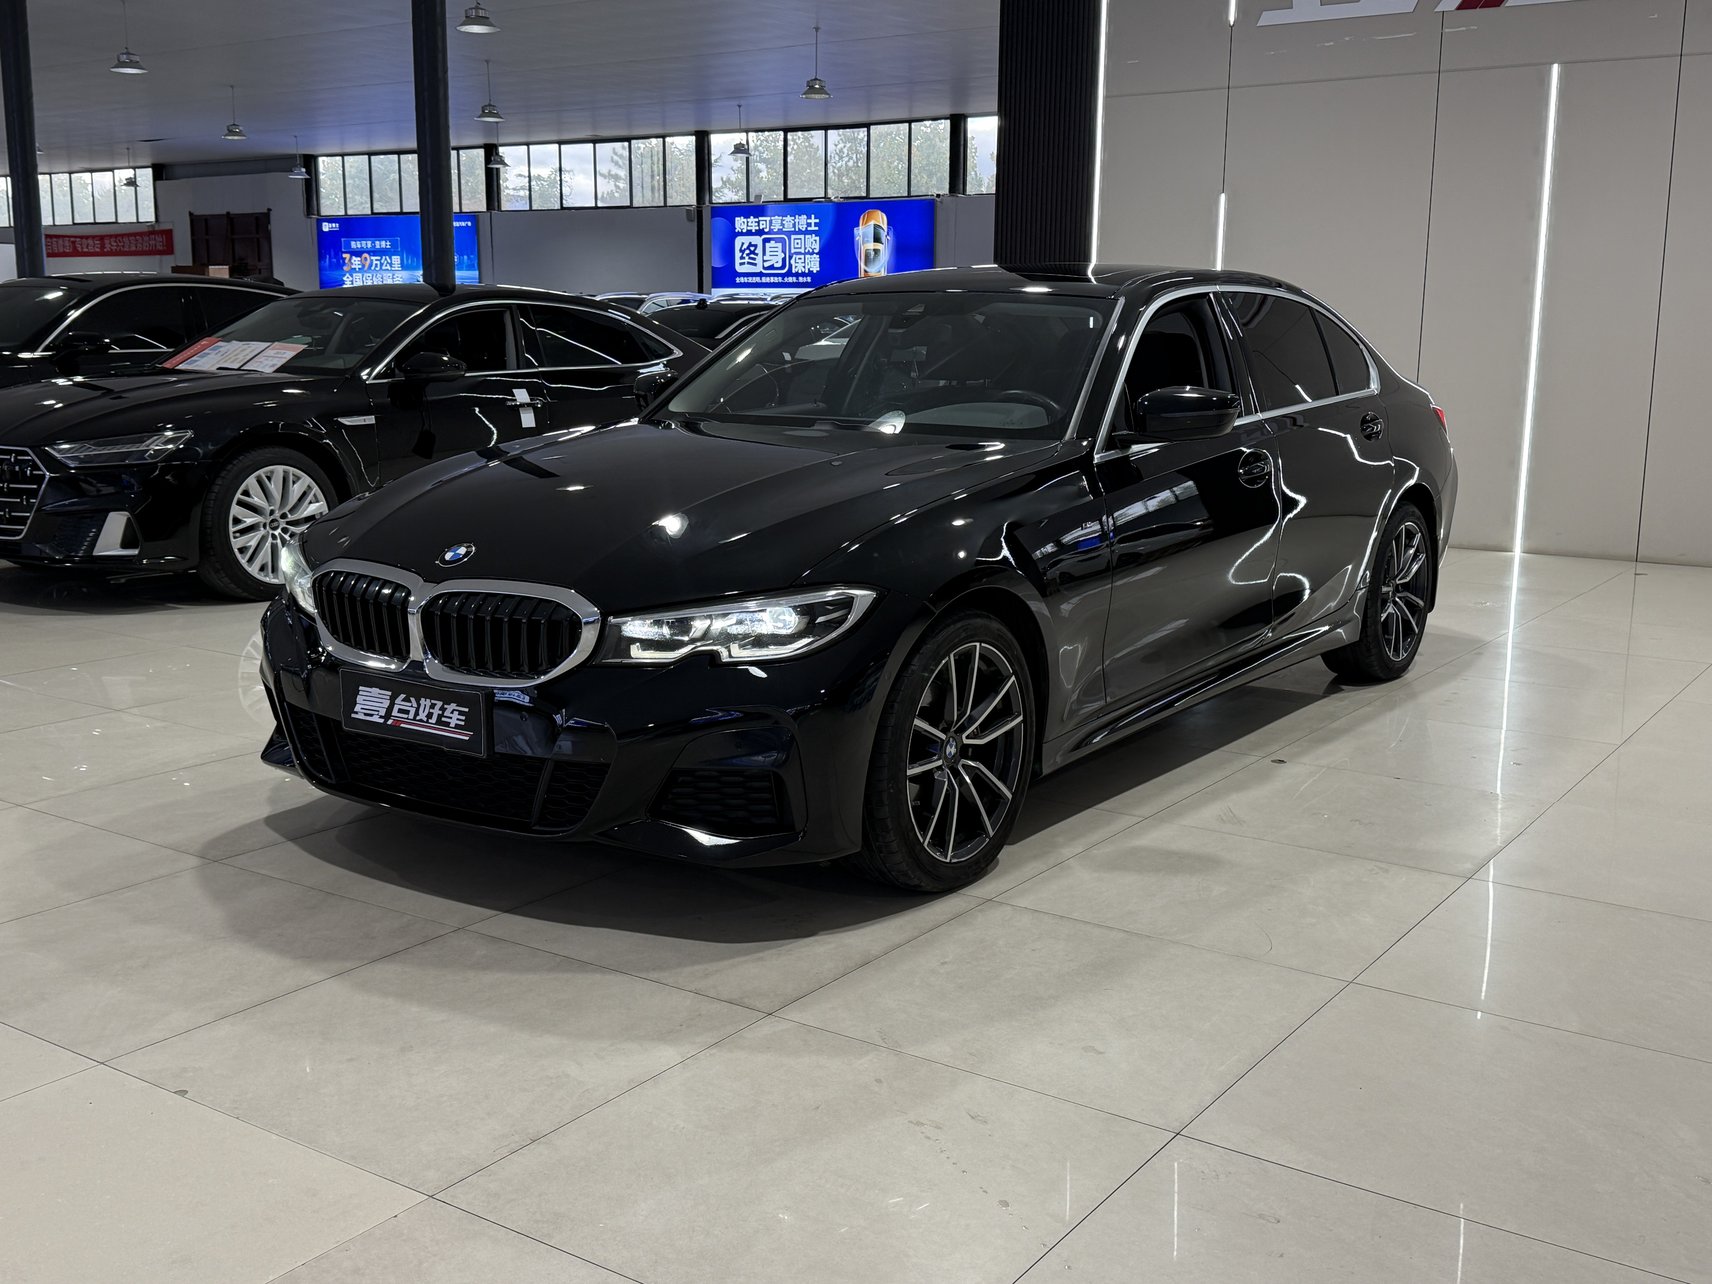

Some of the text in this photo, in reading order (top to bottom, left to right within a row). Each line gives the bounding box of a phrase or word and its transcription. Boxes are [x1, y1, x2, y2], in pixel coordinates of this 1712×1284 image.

[735, 214, 819, 233] 购车可享查博士
[790, 234, 820, 254] 回购
[342, 253, 402, 272] 3年9万公里
[738, 240, 786, 269] 终身
[790, 254, 820, 274] 保障
[351, 685, 469, 728] 壹台好车
